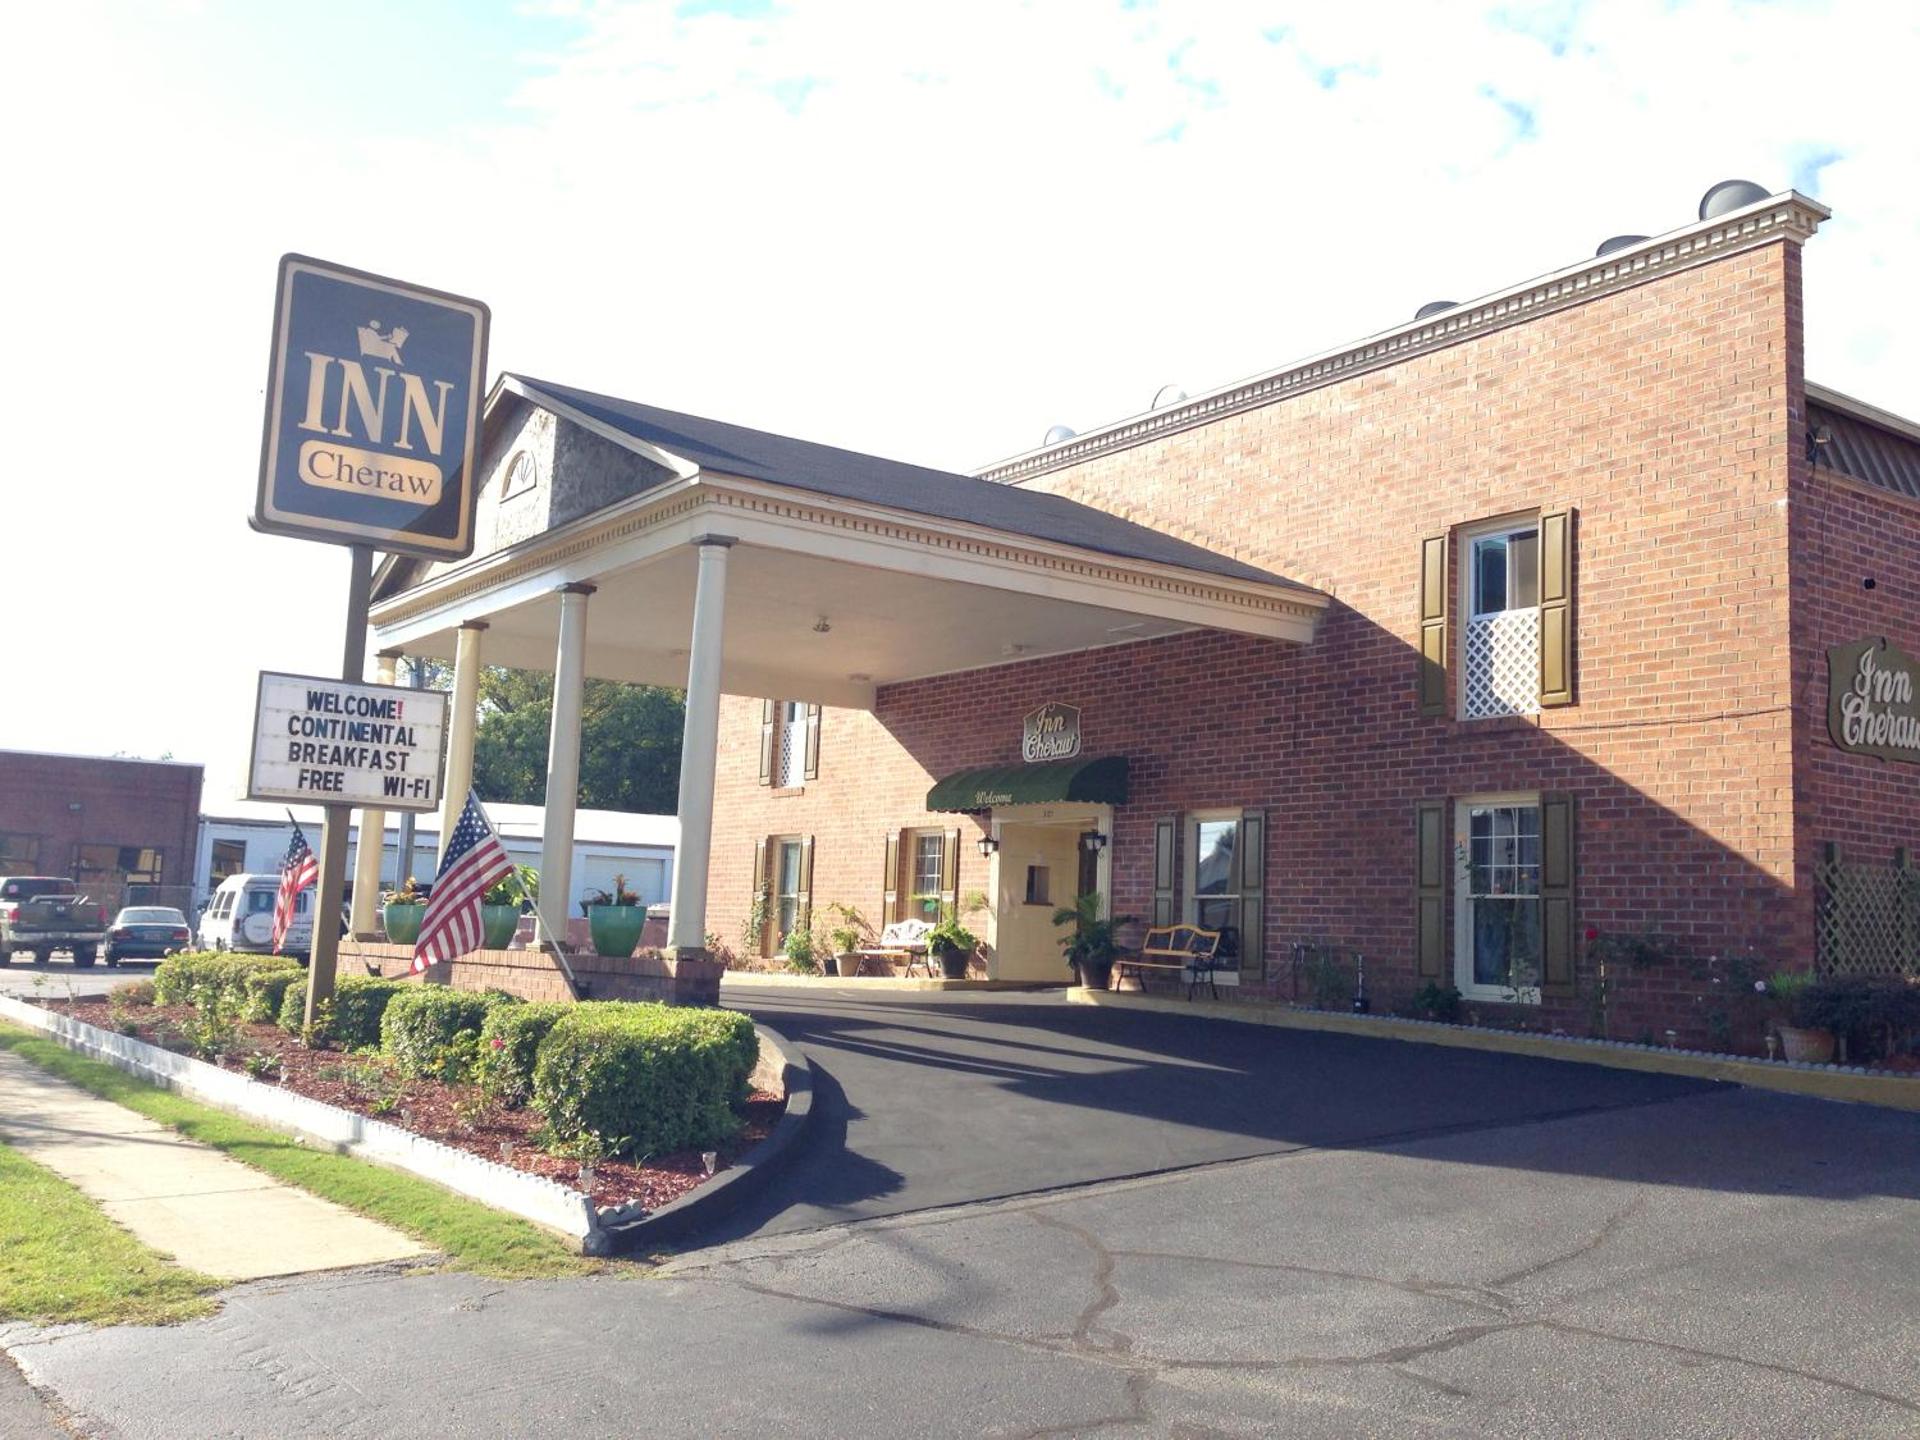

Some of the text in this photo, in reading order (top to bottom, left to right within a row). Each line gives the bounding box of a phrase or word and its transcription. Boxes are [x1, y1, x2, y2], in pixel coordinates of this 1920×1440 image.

[299, 352, 454, 455] INN
[308, 450, 434, 496] Cheraw
[1855, 646, 1913, 703] Inn
[307, 690, 404, 720] WELCOME!
[288, 715, 417, 747] CONTINENTAL
[1037, 708, 1065, 733] Inn
[288, 742, 410, 772] BREAKFAST
[1027, 732, 1076, 758] Cheraw
[298, 769, 430, 799] FREE WI-FI
